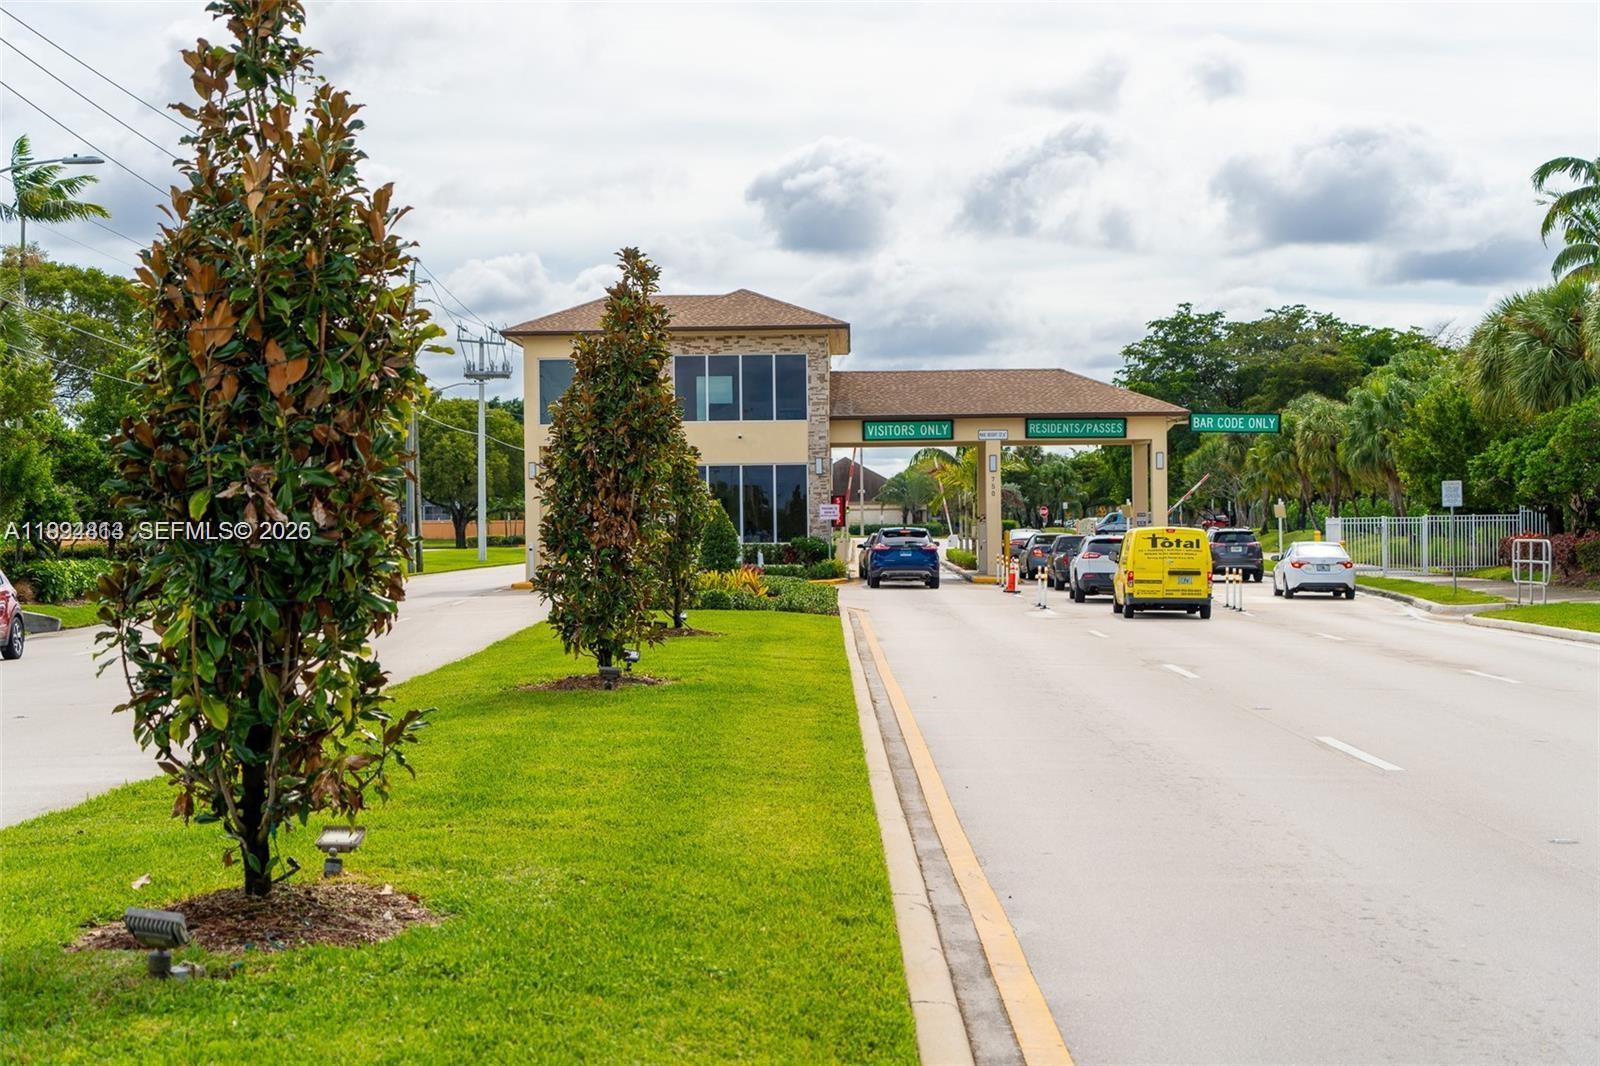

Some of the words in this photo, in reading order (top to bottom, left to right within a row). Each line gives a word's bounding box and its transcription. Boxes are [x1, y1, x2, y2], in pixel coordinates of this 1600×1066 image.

[1029, 423, 1123, 434] RESIDENTS/PASSES
[1193, 417, 1214, 429] BAR
[1217, 417, 1245, 429] CODE
[1248, 417, 1276, 429] ONLY
[867, 424, 915, 436] VISITORS
[920, 424, 949, 436] ONLY
